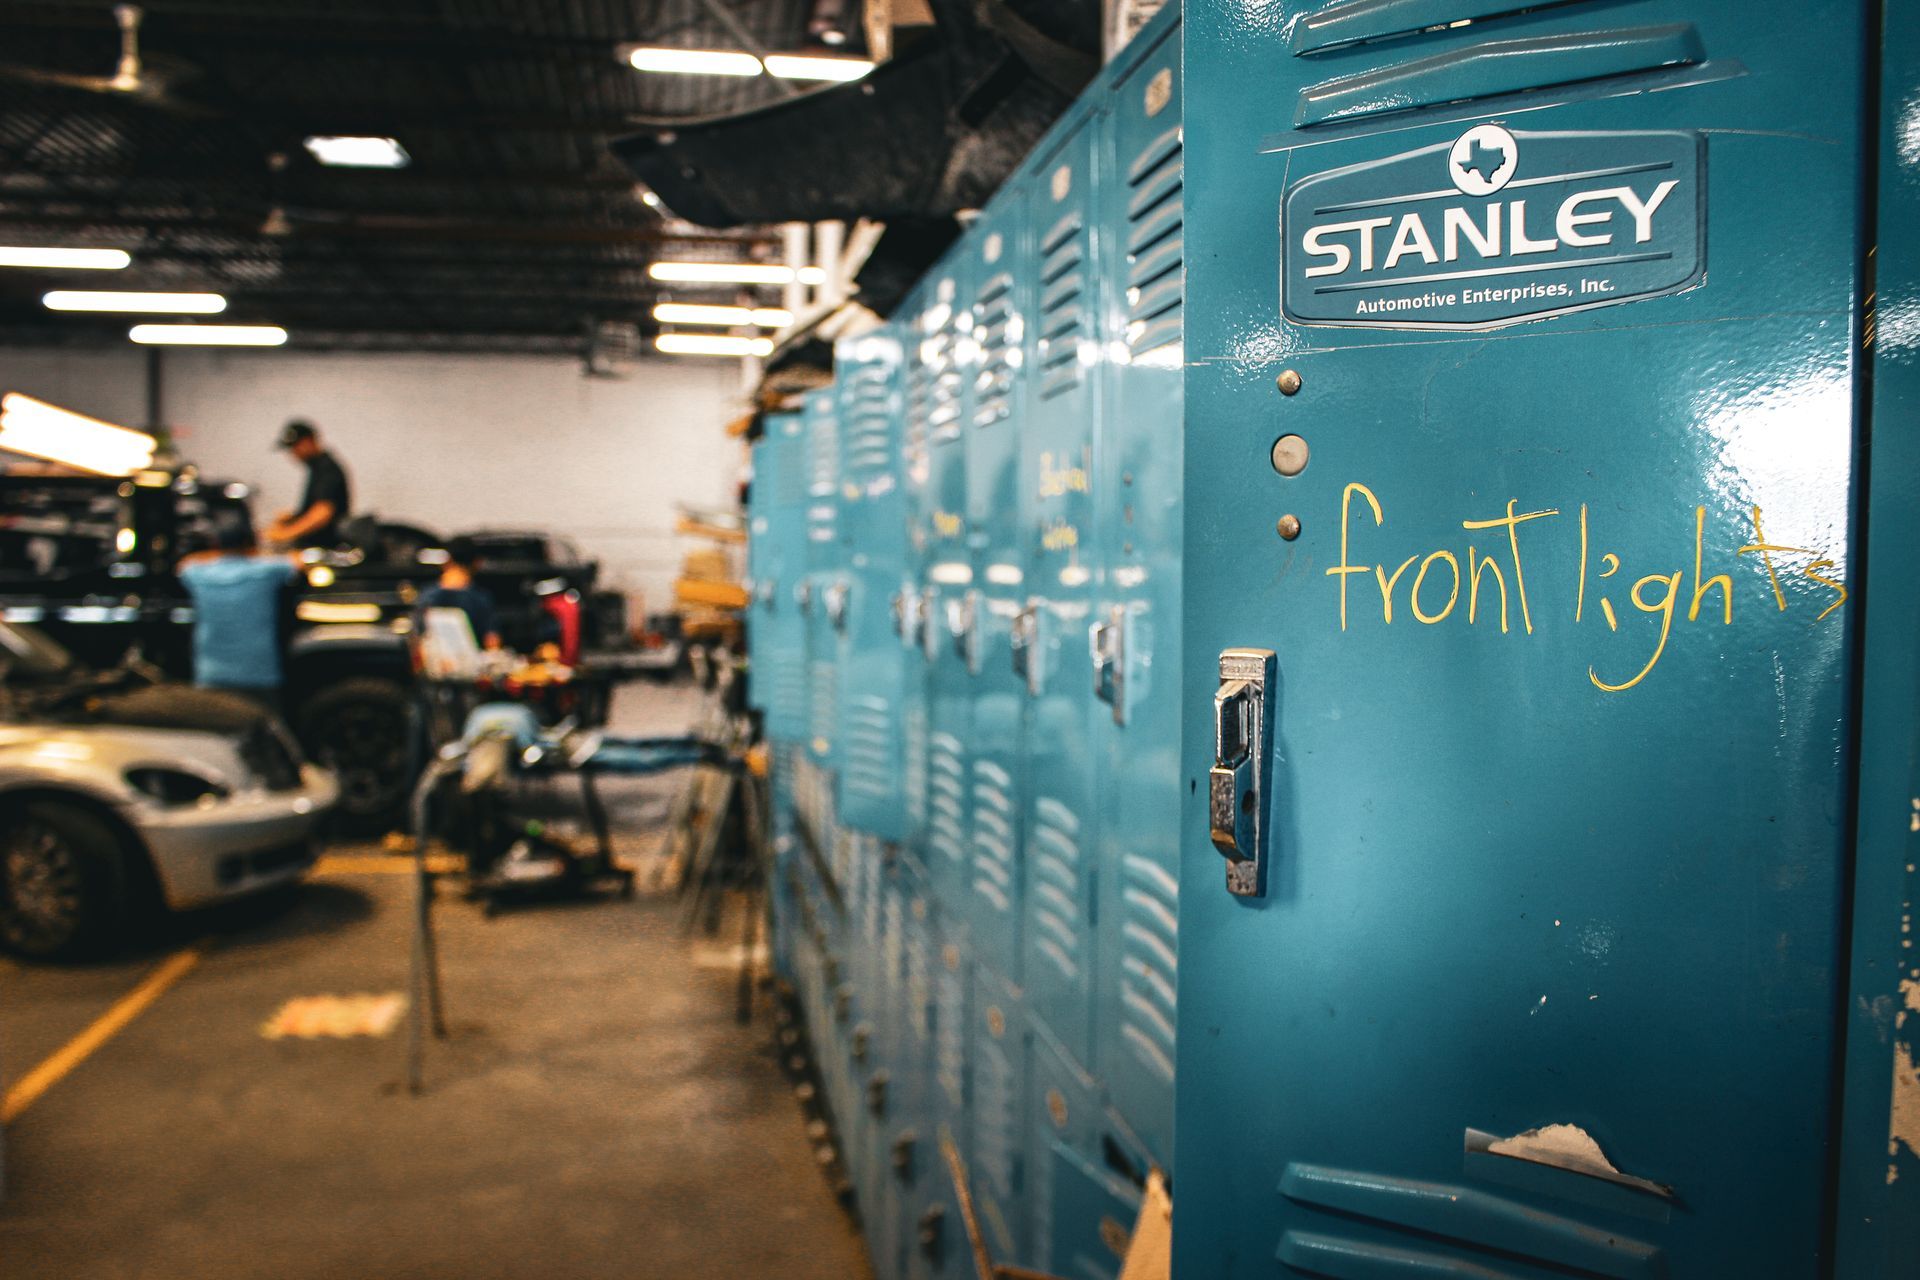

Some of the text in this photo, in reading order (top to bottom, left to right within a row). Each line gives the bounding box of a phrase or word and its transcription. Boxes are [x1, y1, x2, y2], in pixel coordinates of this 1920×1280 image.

[1302, 179, 1680, 278] STANLEY
[1356, 277, 1615, 314] Automotive Enterprises, Inc.
[1326, 482, 1848, 692] front lights
